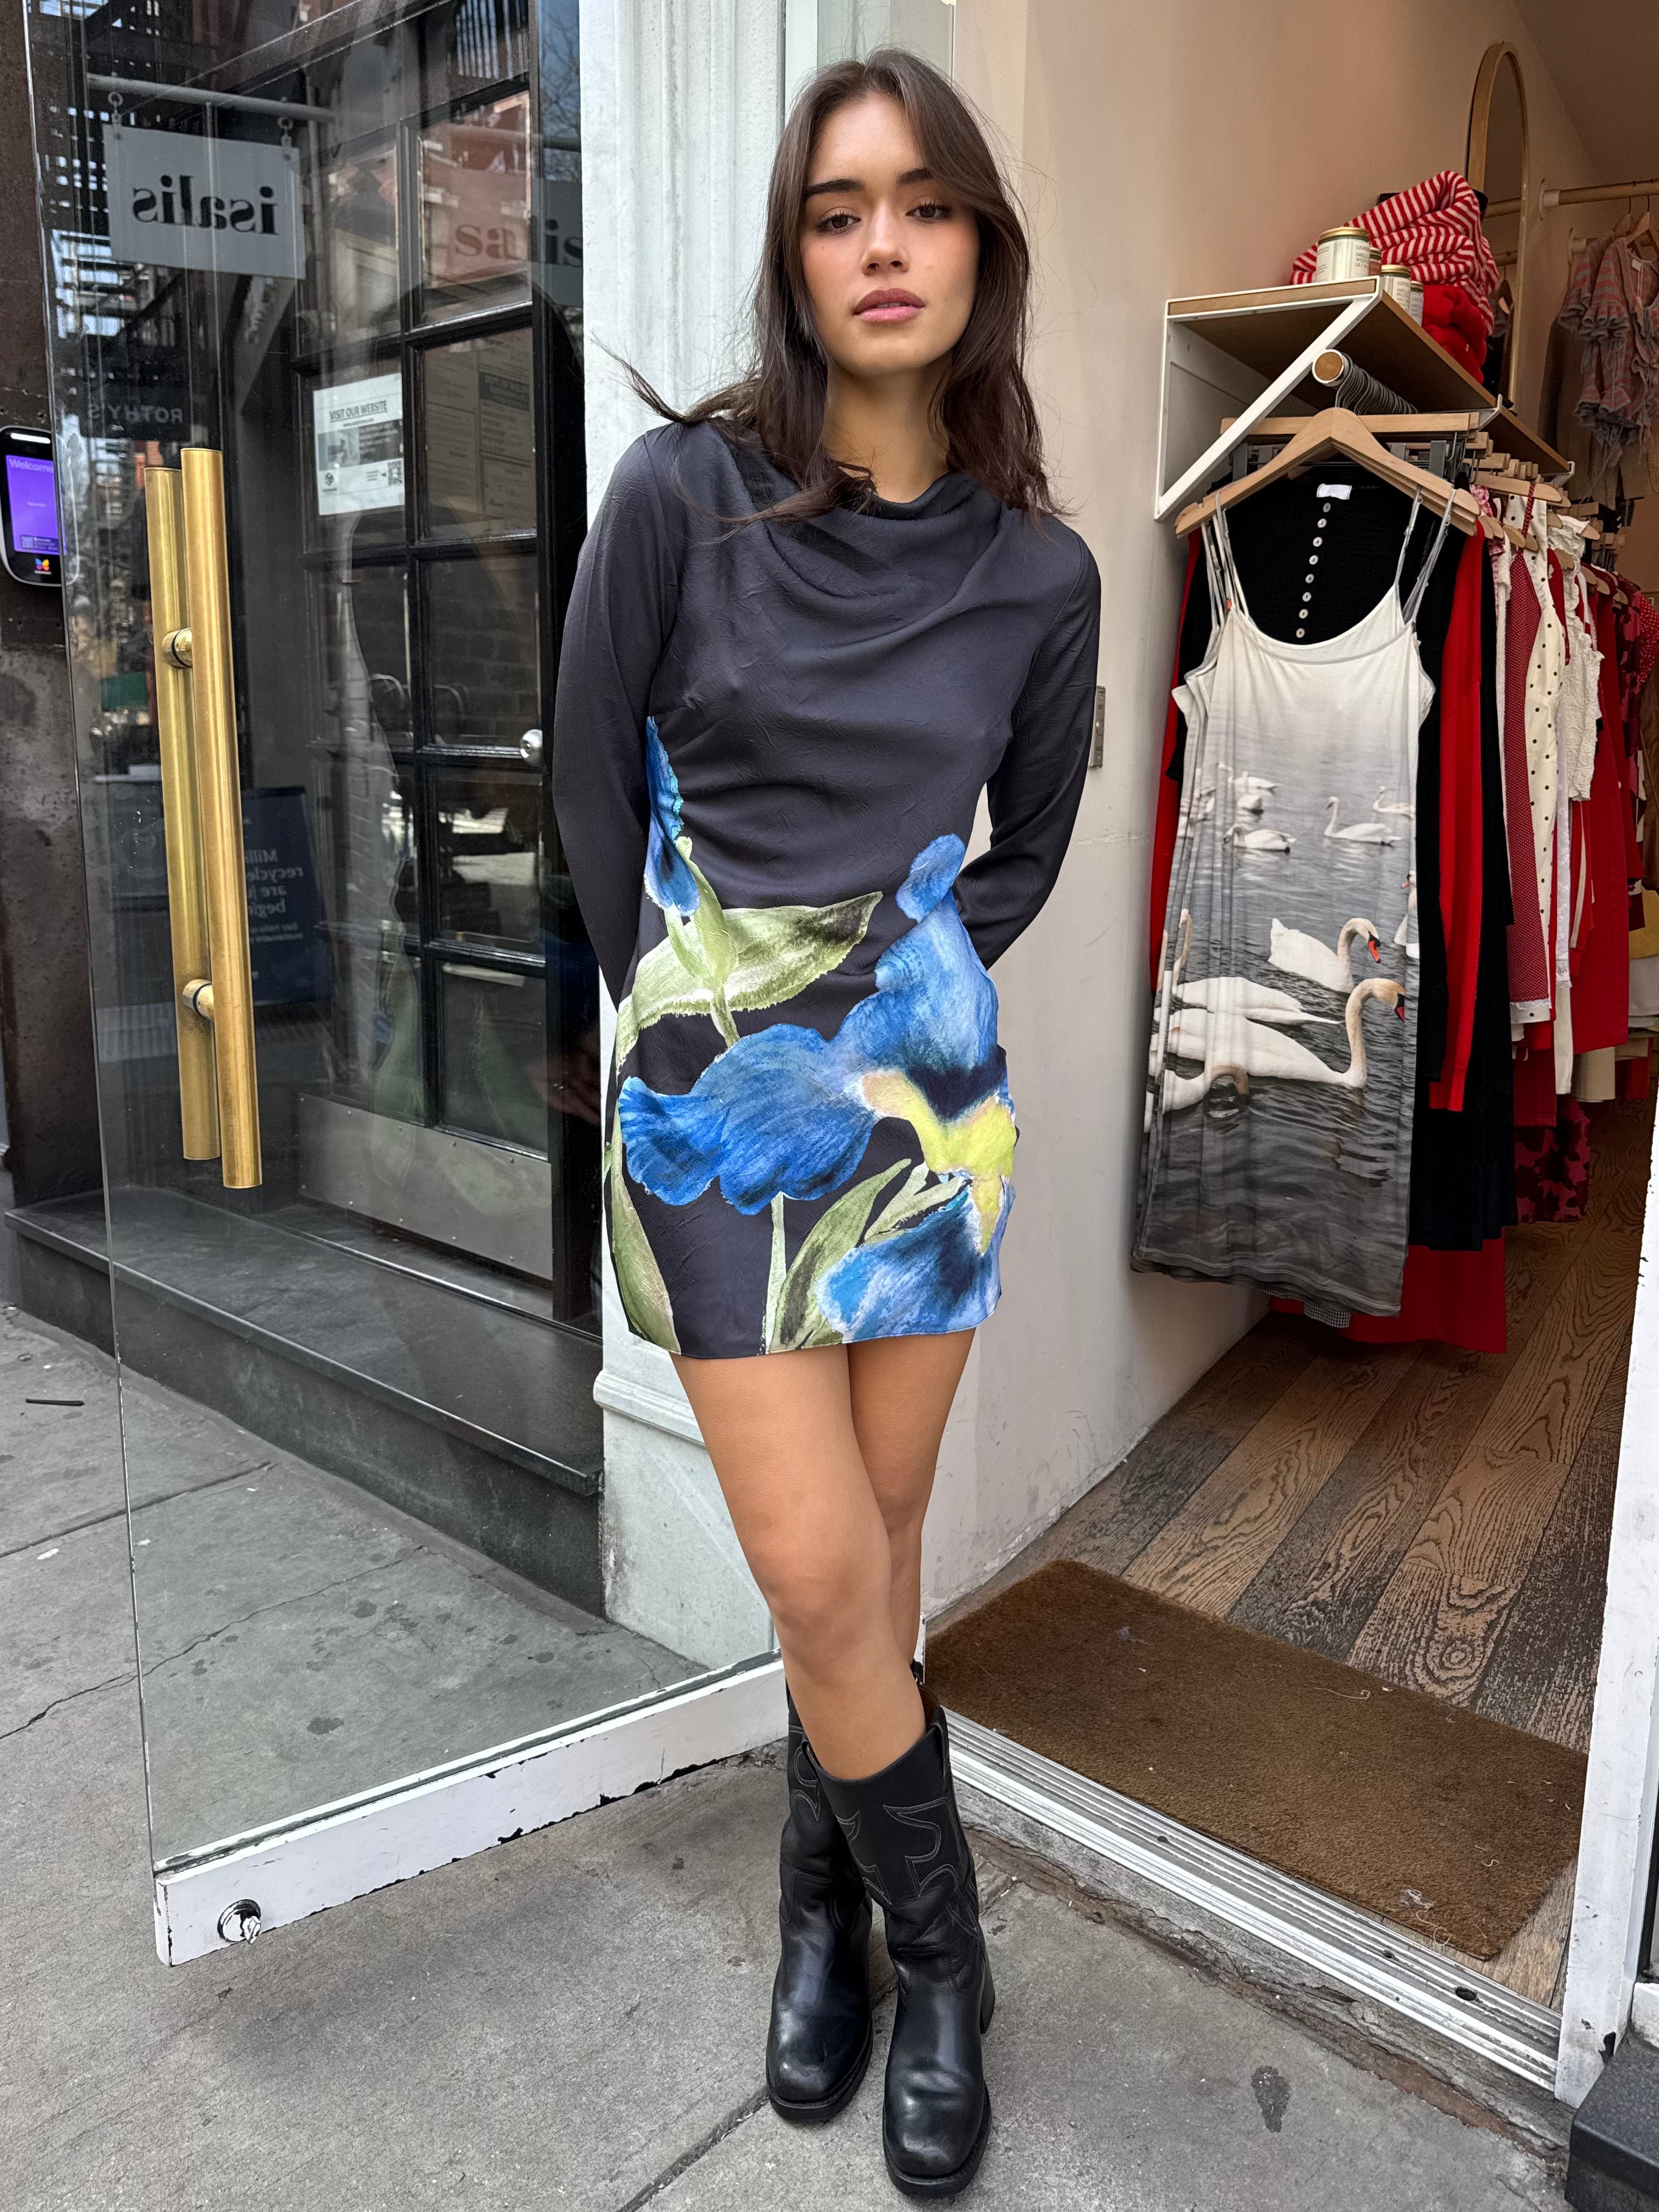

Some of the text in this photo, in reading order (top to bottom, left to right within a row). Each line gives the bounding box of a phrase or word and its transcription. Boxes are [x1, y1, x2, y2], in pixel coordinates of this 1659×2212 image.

[329, 400, 388, 420] VISIT OUR WEBSITE
